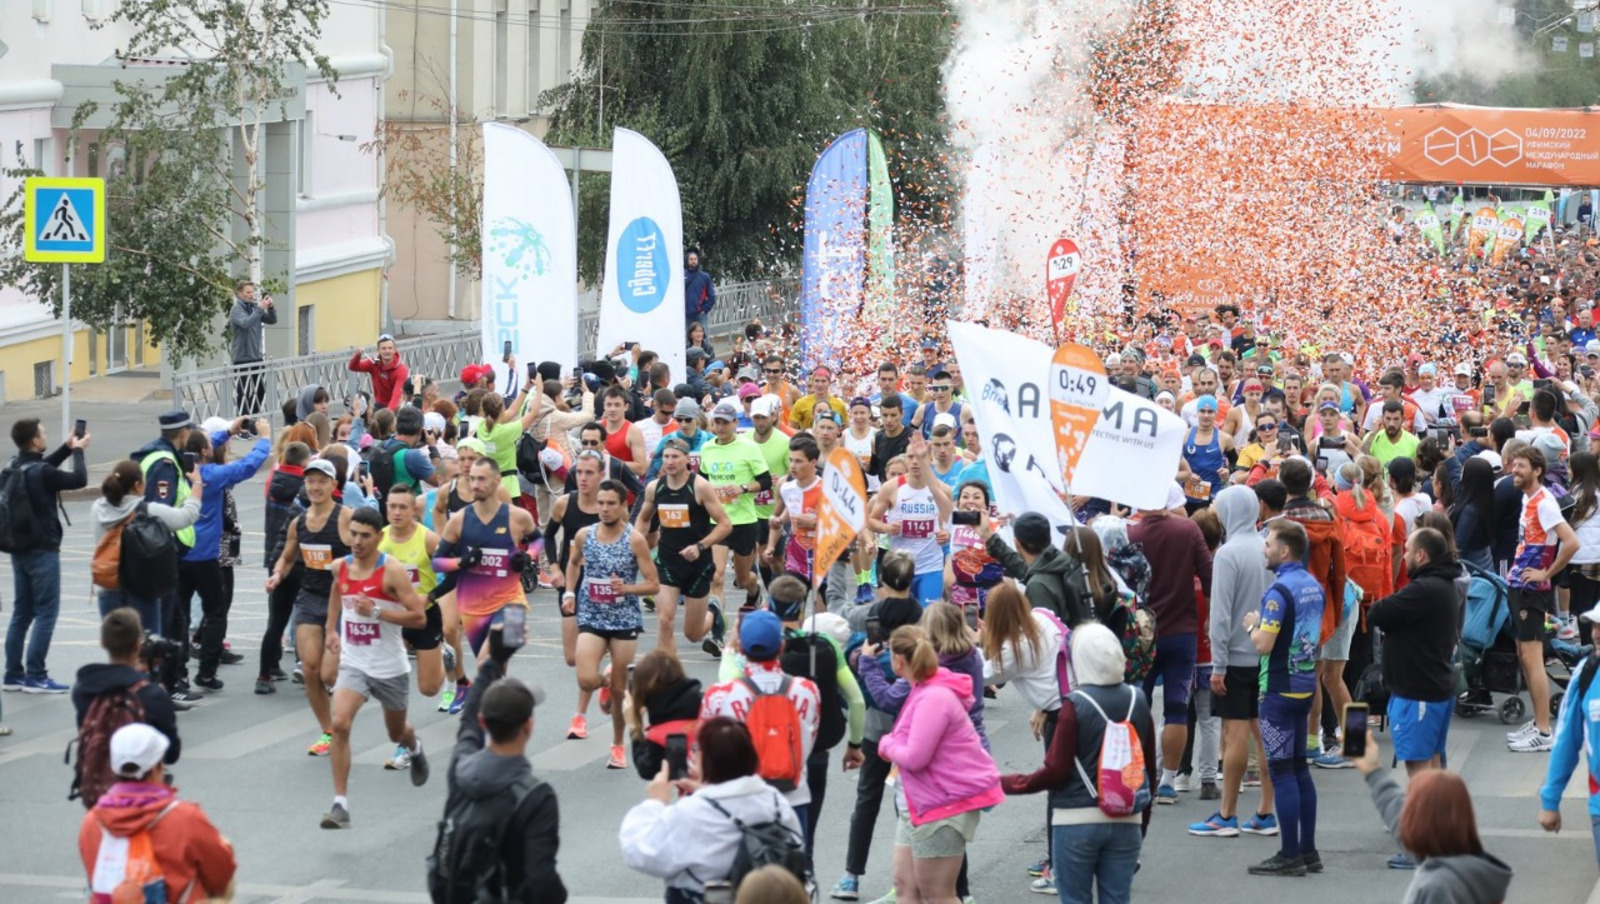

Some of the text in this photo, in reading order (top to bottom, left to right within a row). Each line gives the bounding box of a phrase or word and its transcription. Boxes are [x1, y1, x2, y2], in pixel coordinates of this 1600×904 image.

[1525, 128, 1587, 139] 04/09/2022
[1525, 141, 1571, 150] УФИМСКИЙ
[1525, 151, 1599, 161] МЕЖДУНАРОДНЫЙ
[1525, 161, 1565, 170] МАРАФОН
[1059, 369, 1097, 395] 0:49
[1122, 436, 1143, 447] WITH
[1144, 441, 1155, 449] US
[832, 471, 855, 516] 0:44
[901, 503, 935, 515] RUSSIA
[665, 510, 682, 520] 163
[907, 521, 930, 531] 1141
[593, 584, 617, 595] 135
[348, 624, 375, 636] 1634
